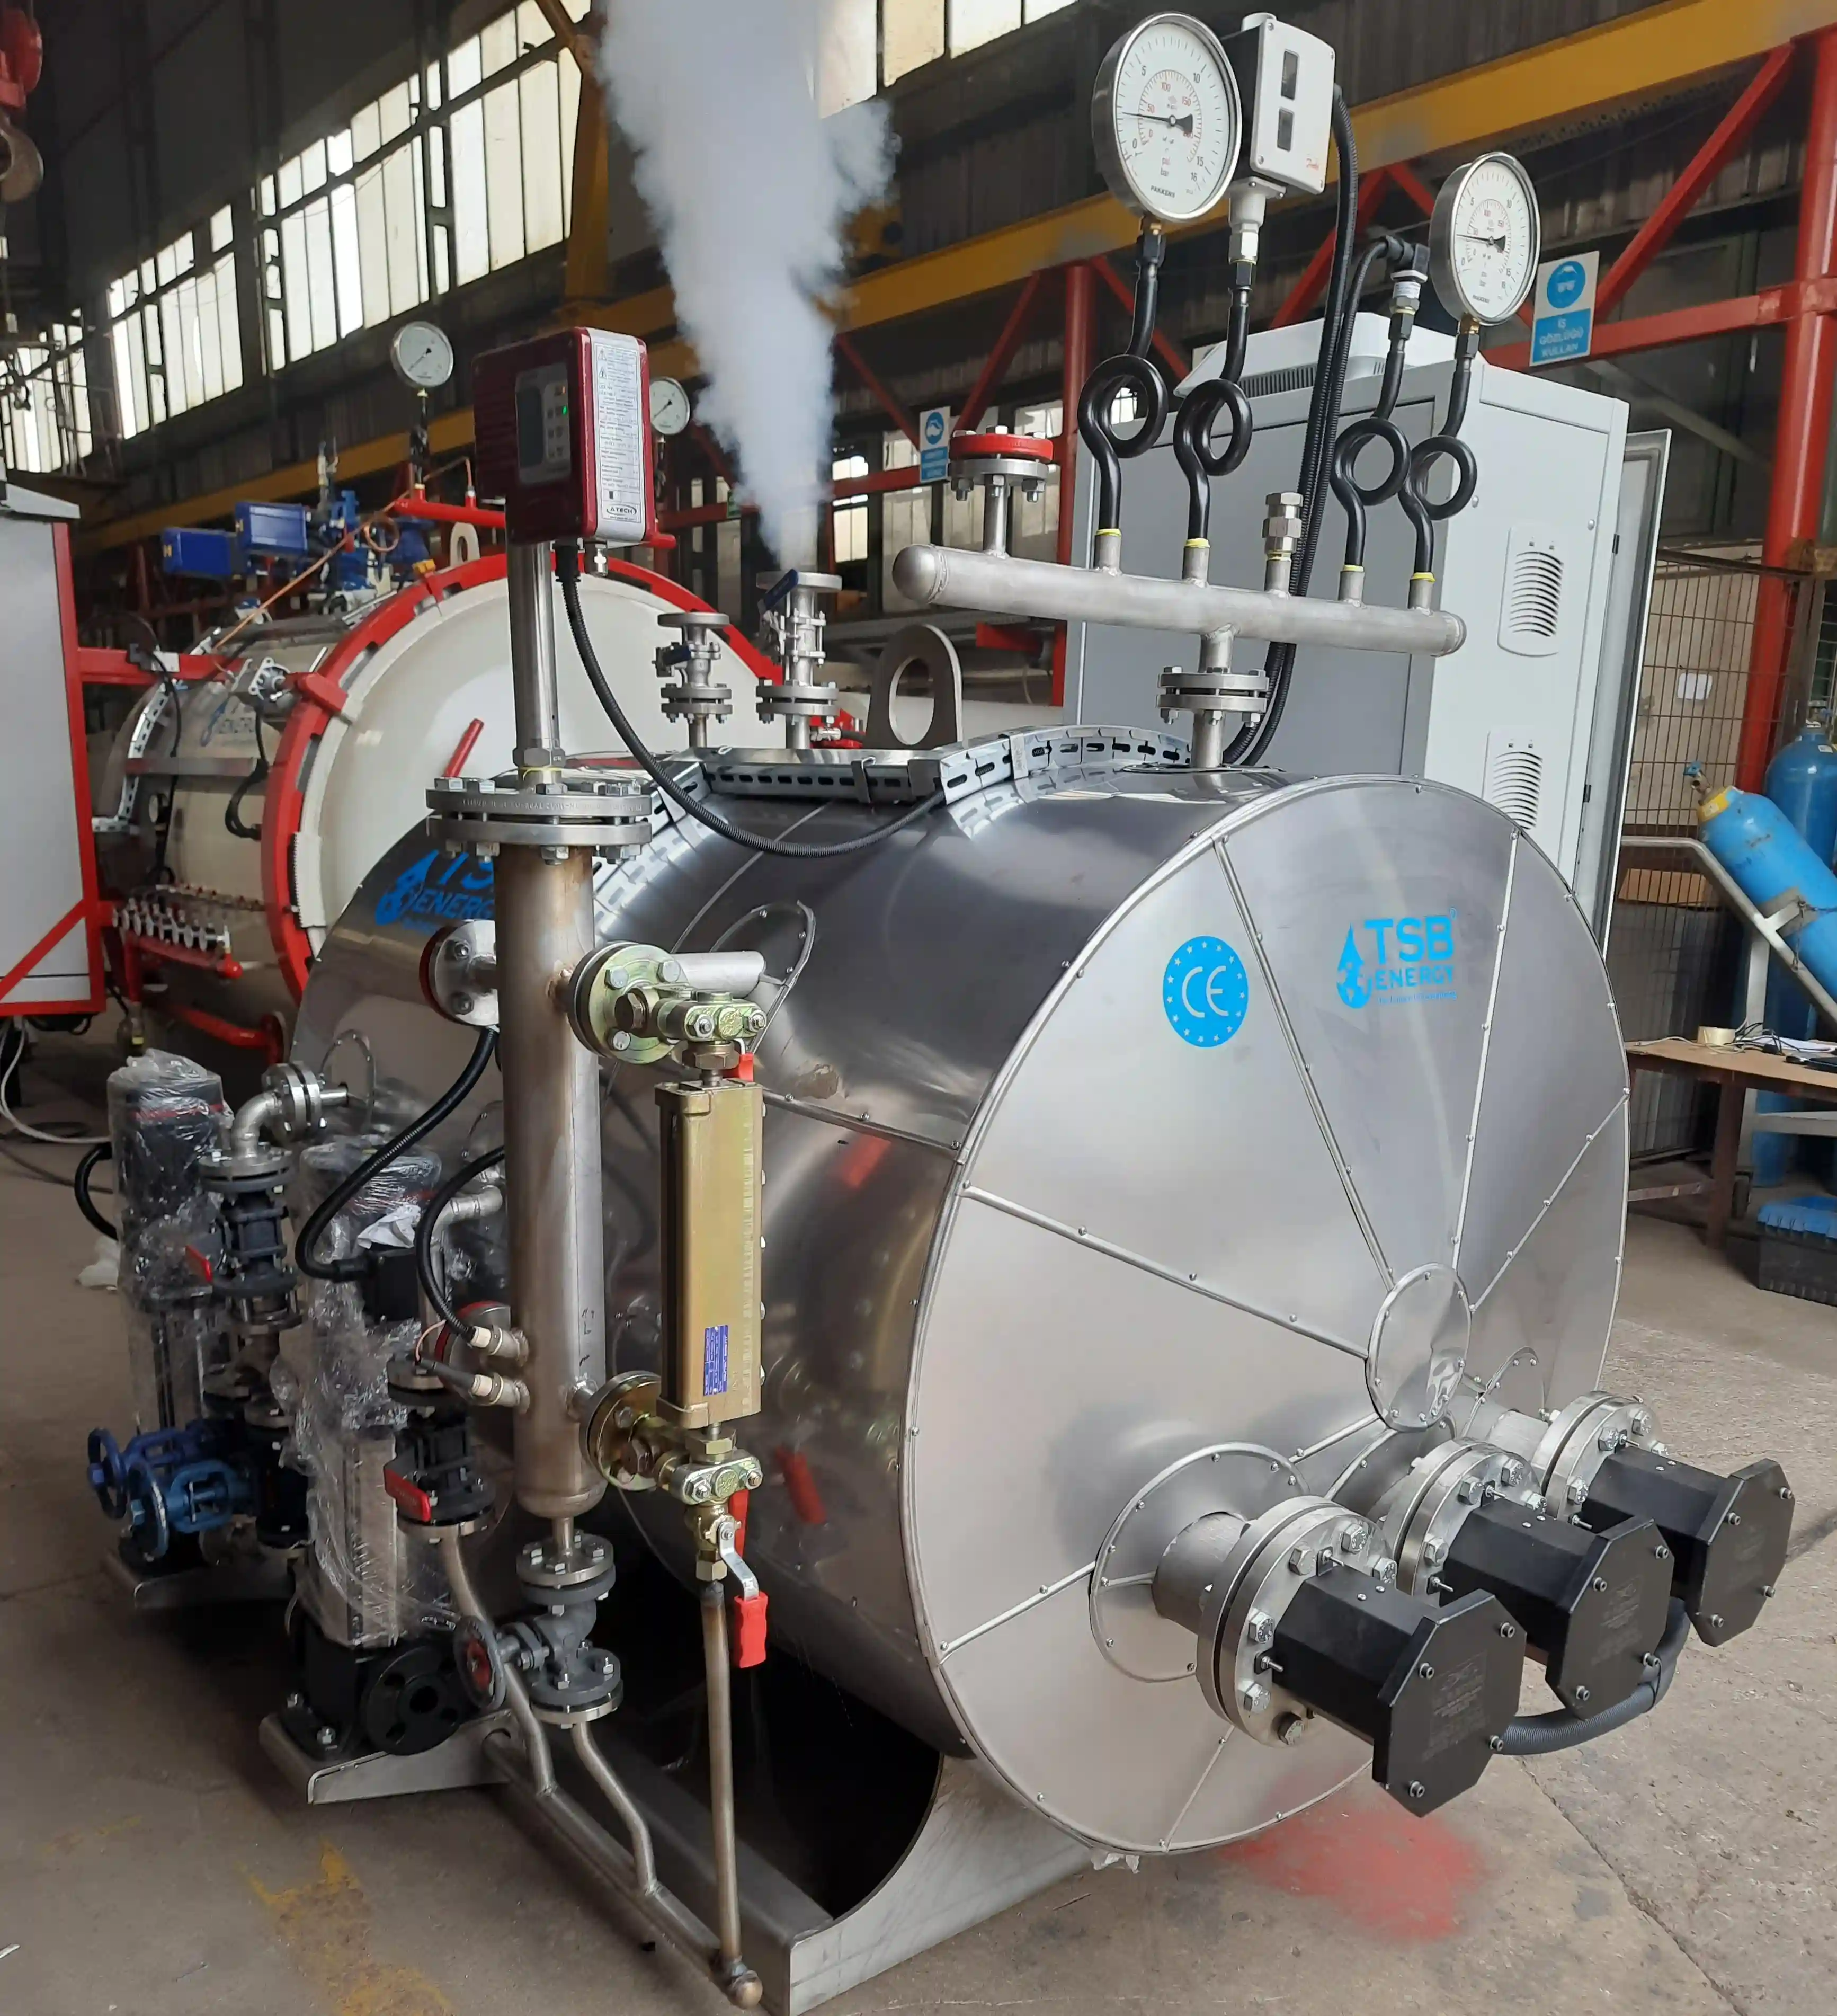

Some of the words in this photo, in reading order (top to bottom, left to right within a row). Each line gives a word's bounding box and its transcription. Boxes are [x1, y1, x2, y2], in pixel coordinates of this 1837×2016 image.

[1141, 65, 1147, 77] 5
[1193, 72, 1201, 84] 10
[1161, 81, 1171, 92] 100
[1182, 95, 1192, 107] 150
[1132, 137, 1138, 149] 0
[1196, 155, 1205, 167] 15
[1190, 171, 1198, 182] 16
[1470, 196, 1475, 206] 5
[1506, 198, 1512, 209] 10
[1461, 256, 1466, 266] 0
[1364, 915, 1455, 965] TSB
[1377, 965, 1455, 991] ENERGY
[1181, 964, 1229, 1018] CE
